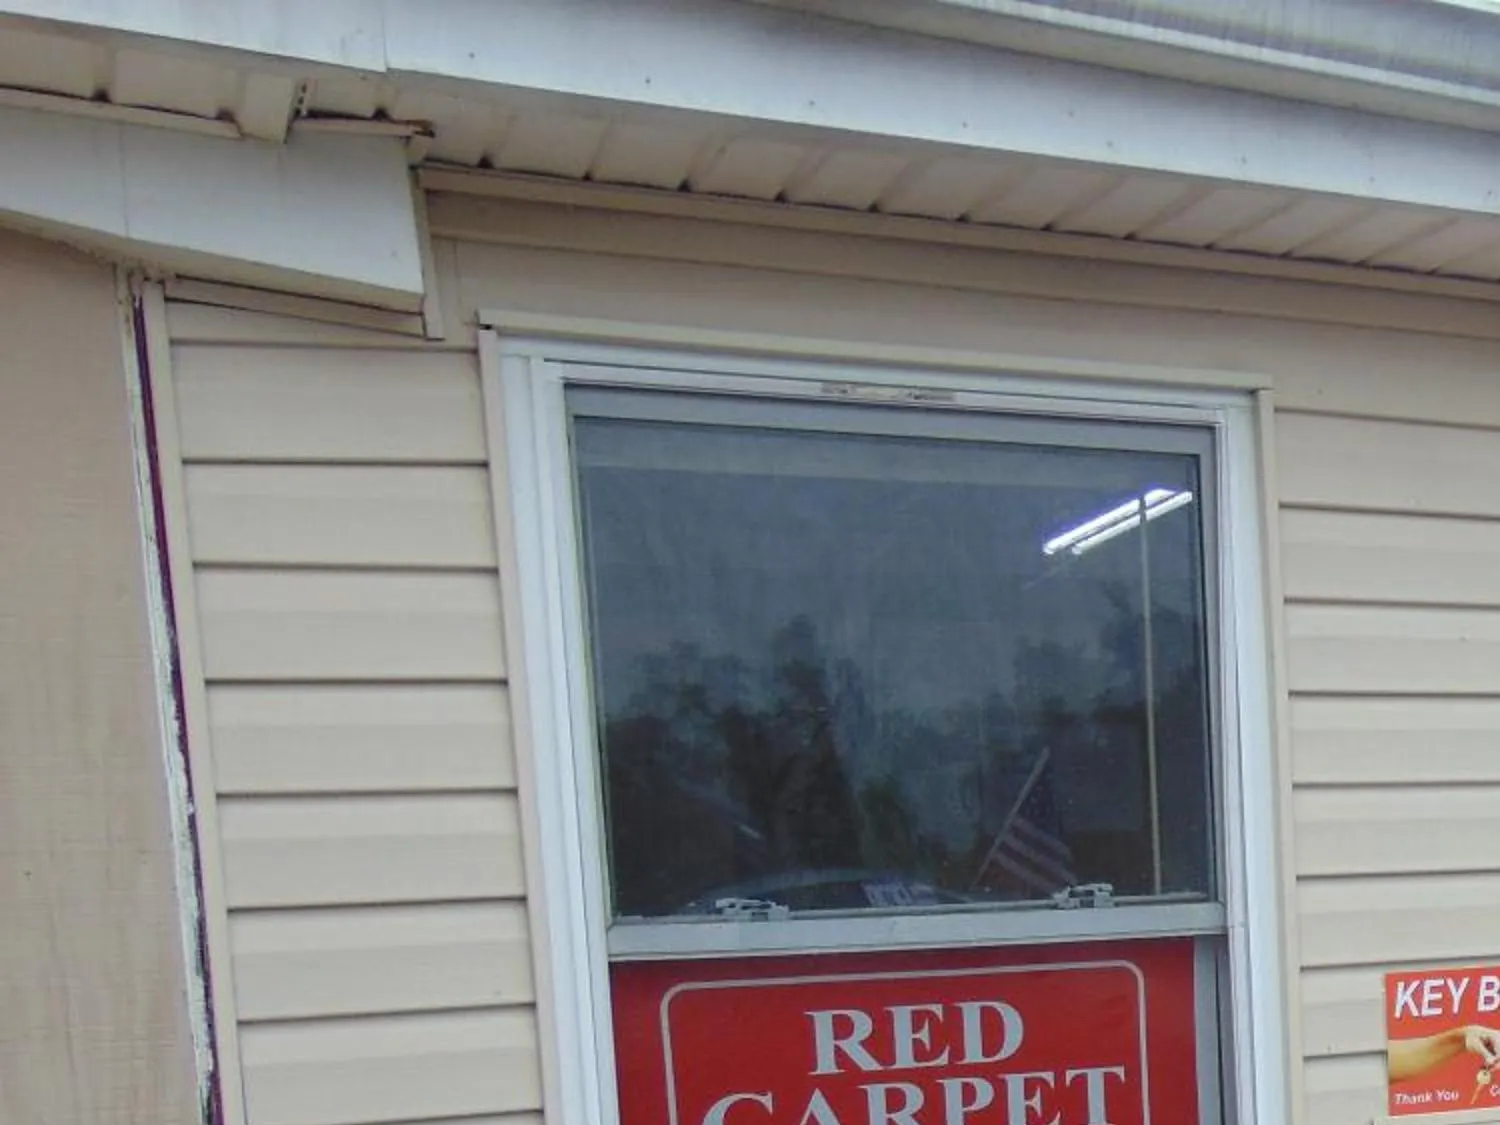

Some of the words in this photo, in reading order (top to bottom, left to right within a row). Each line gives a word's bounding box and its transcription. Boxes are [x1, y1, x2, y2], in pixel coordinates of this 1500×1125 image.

[1394, 976, 1470, 1018] KEY
[805, 1000, 1025, 1076] RED
[1395, 1090, 1433, 1105] Thank
[1435, 1089, 1461, 1102] You
